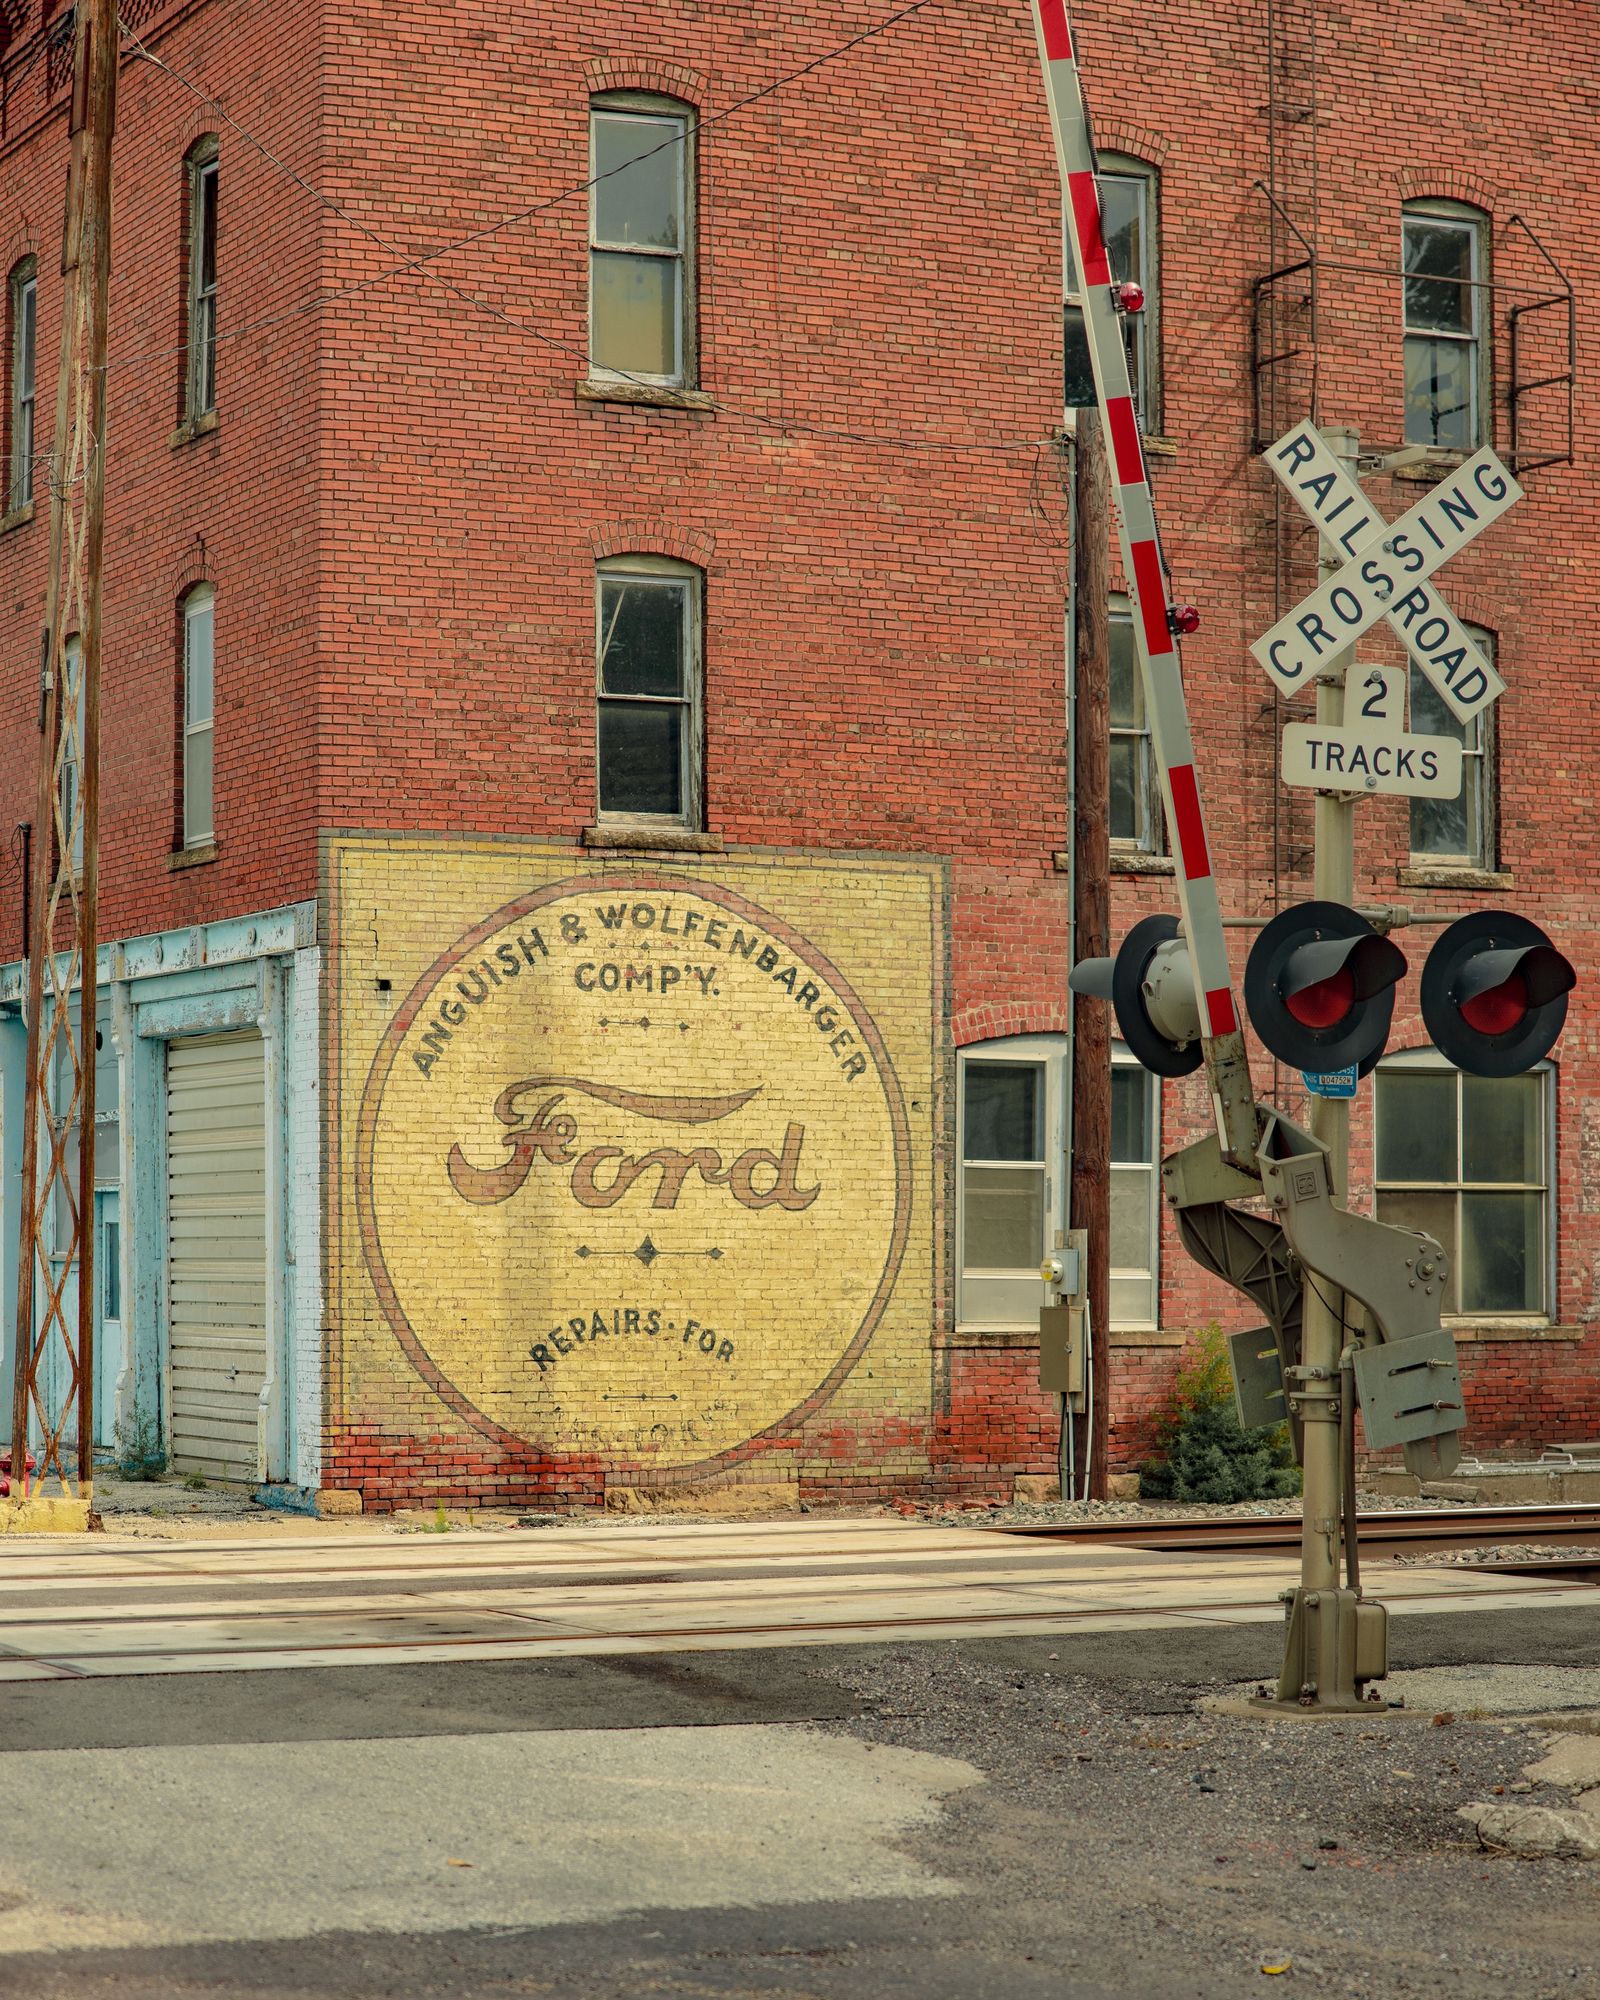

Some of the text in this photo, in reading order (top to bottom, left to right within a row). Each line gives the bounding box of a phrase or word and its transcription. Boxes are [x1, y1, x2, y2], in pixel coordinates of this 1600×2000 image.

[1268, 463, 1508, 679] CROSSING
[1276, 433, 1489, 705] RAIL ROAD
[1306, 740, 1439, 781] TRACKS
[1361, 677, 1388, 718] 2
[411, 902, 868, 1084] ANGUISH & WOLFENBARGER
[446, 1076, 822, 1211] Ford
[528, 1308, 735, 1372] REPAIRS FOR
